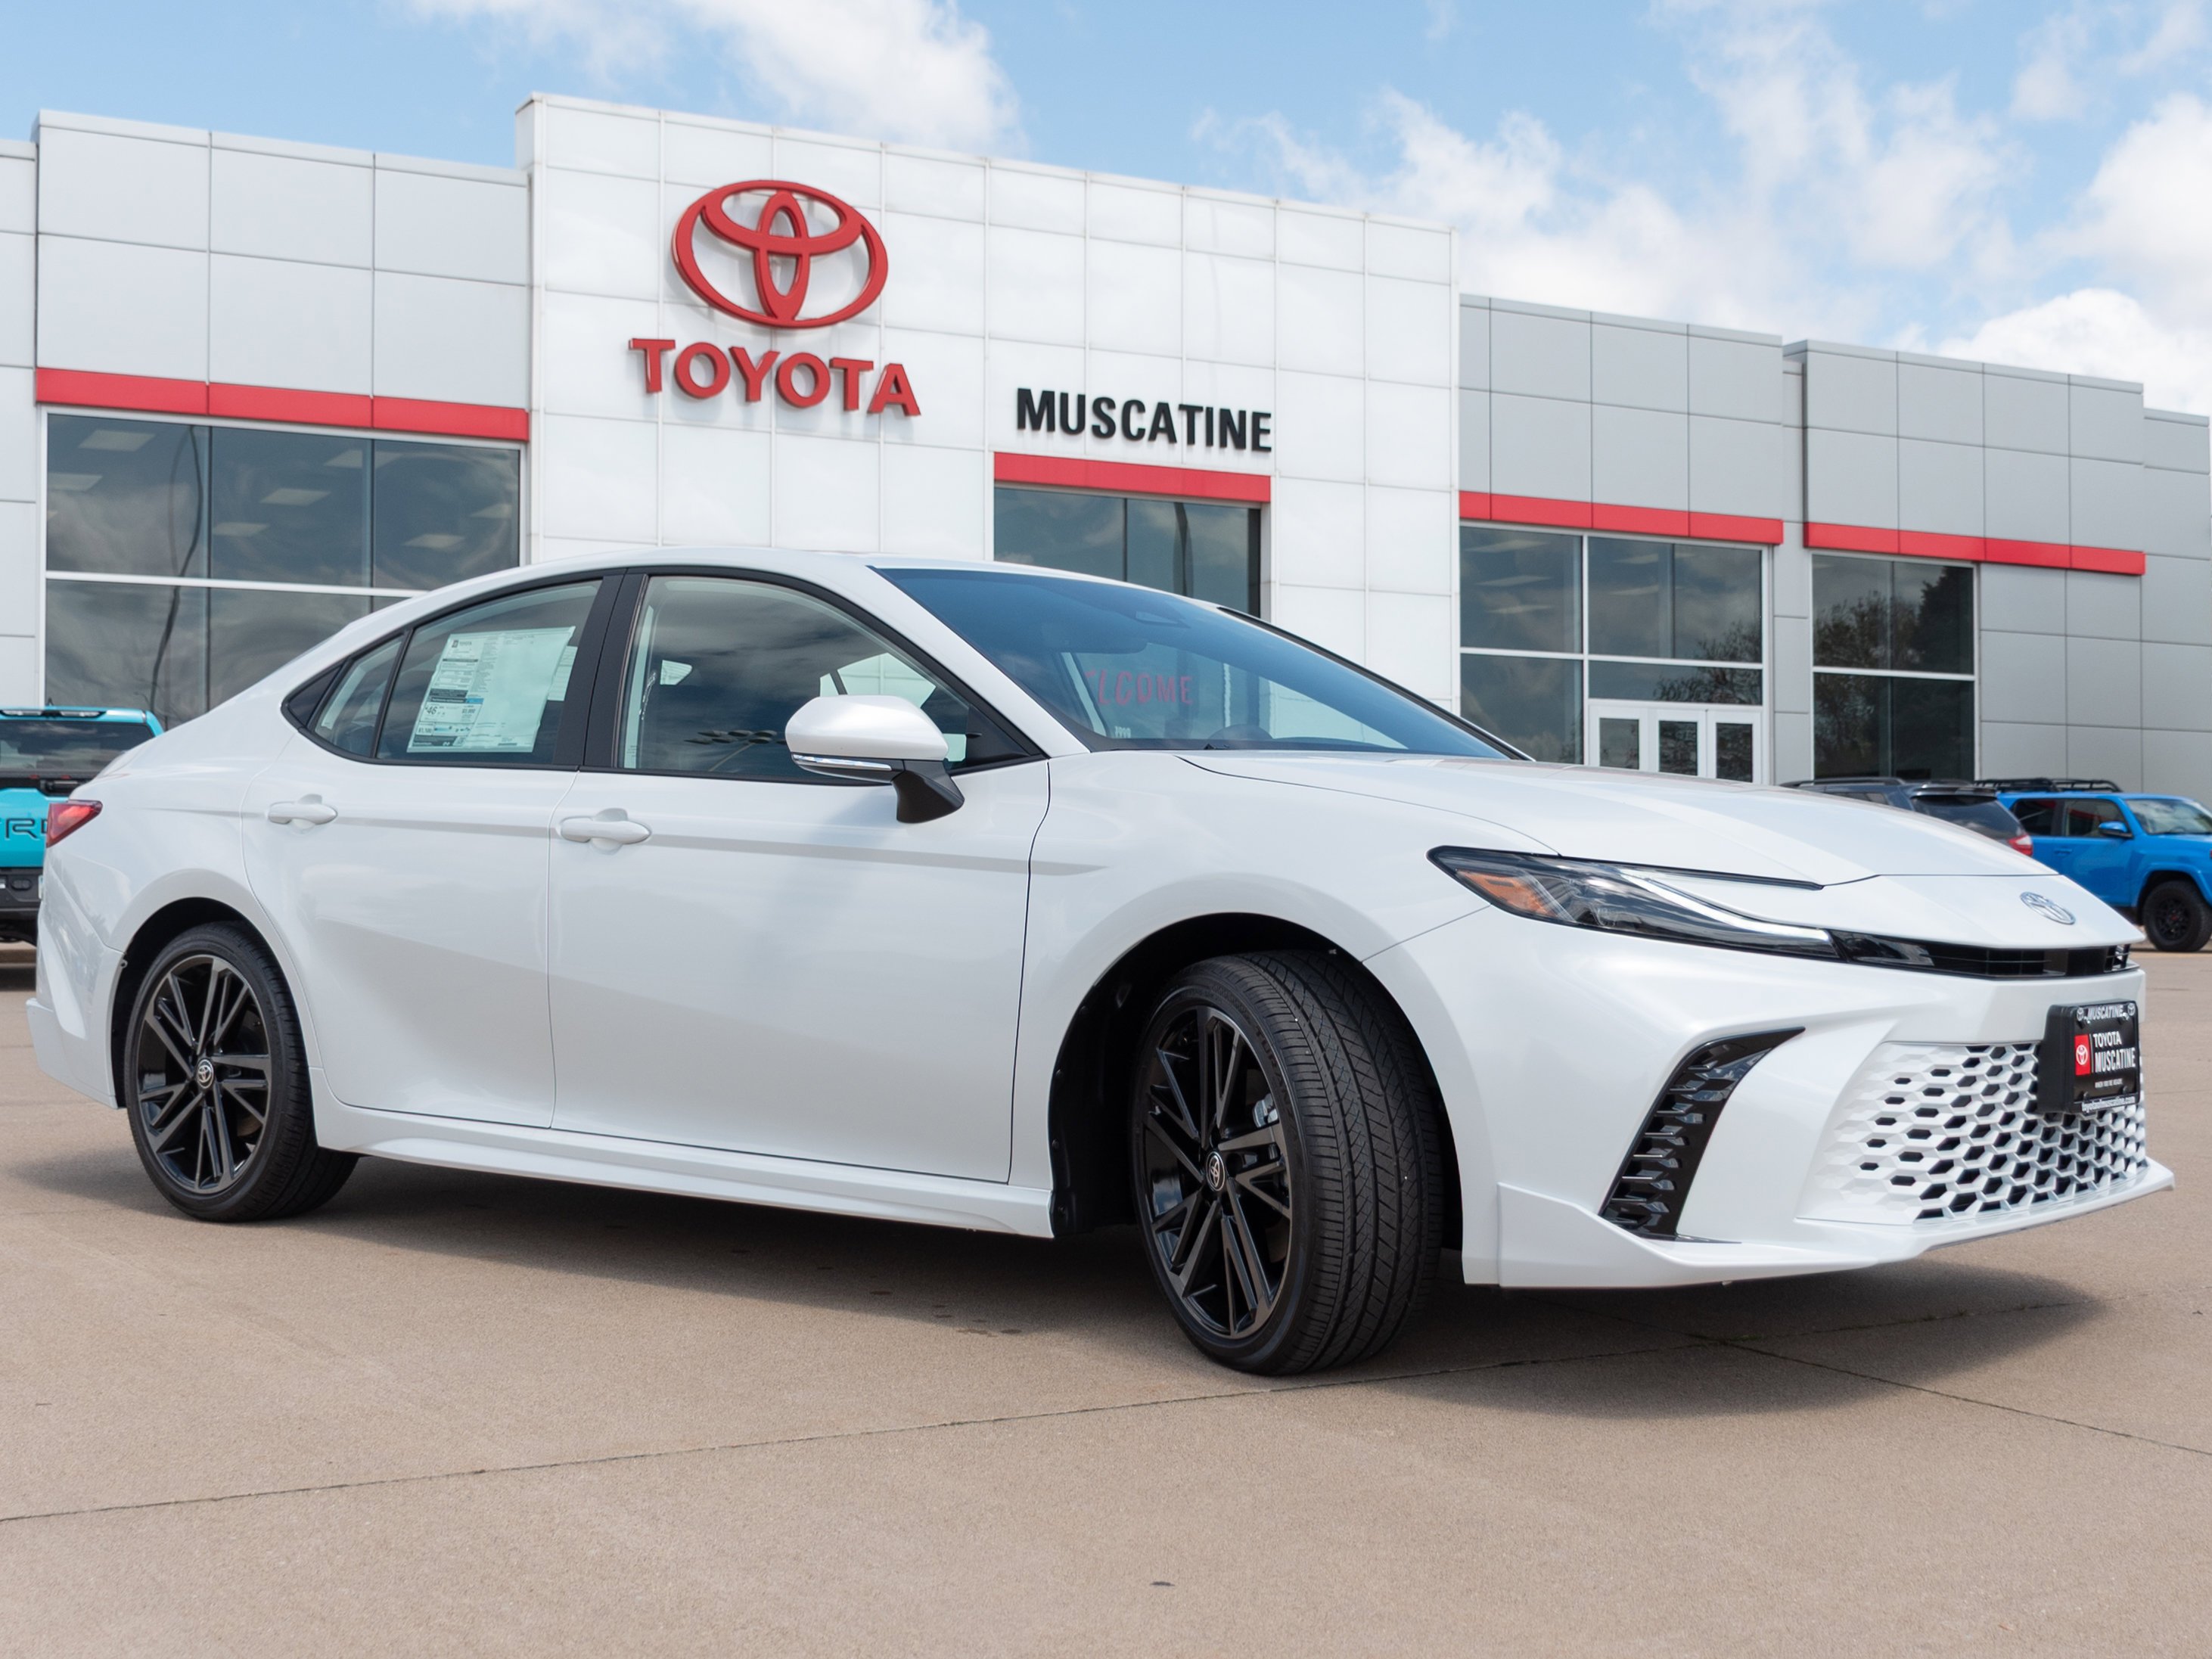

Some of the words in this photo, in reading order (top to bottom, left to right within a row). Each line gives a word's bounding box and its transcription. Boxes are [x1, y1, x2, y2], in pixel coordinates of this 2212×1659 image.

[629, 337, 922, 418] TOYOTA
[1016, 387, 1273, 452] MUSCATINE
[1086, 670, 1193, 704] LCOME
[2087, 1005, 2123, 1019] MUSCATINE
[2093, 1031, 2121, 1047] TOYOTA
[2095, 1047, 2136, 1073] MUSCATINE
